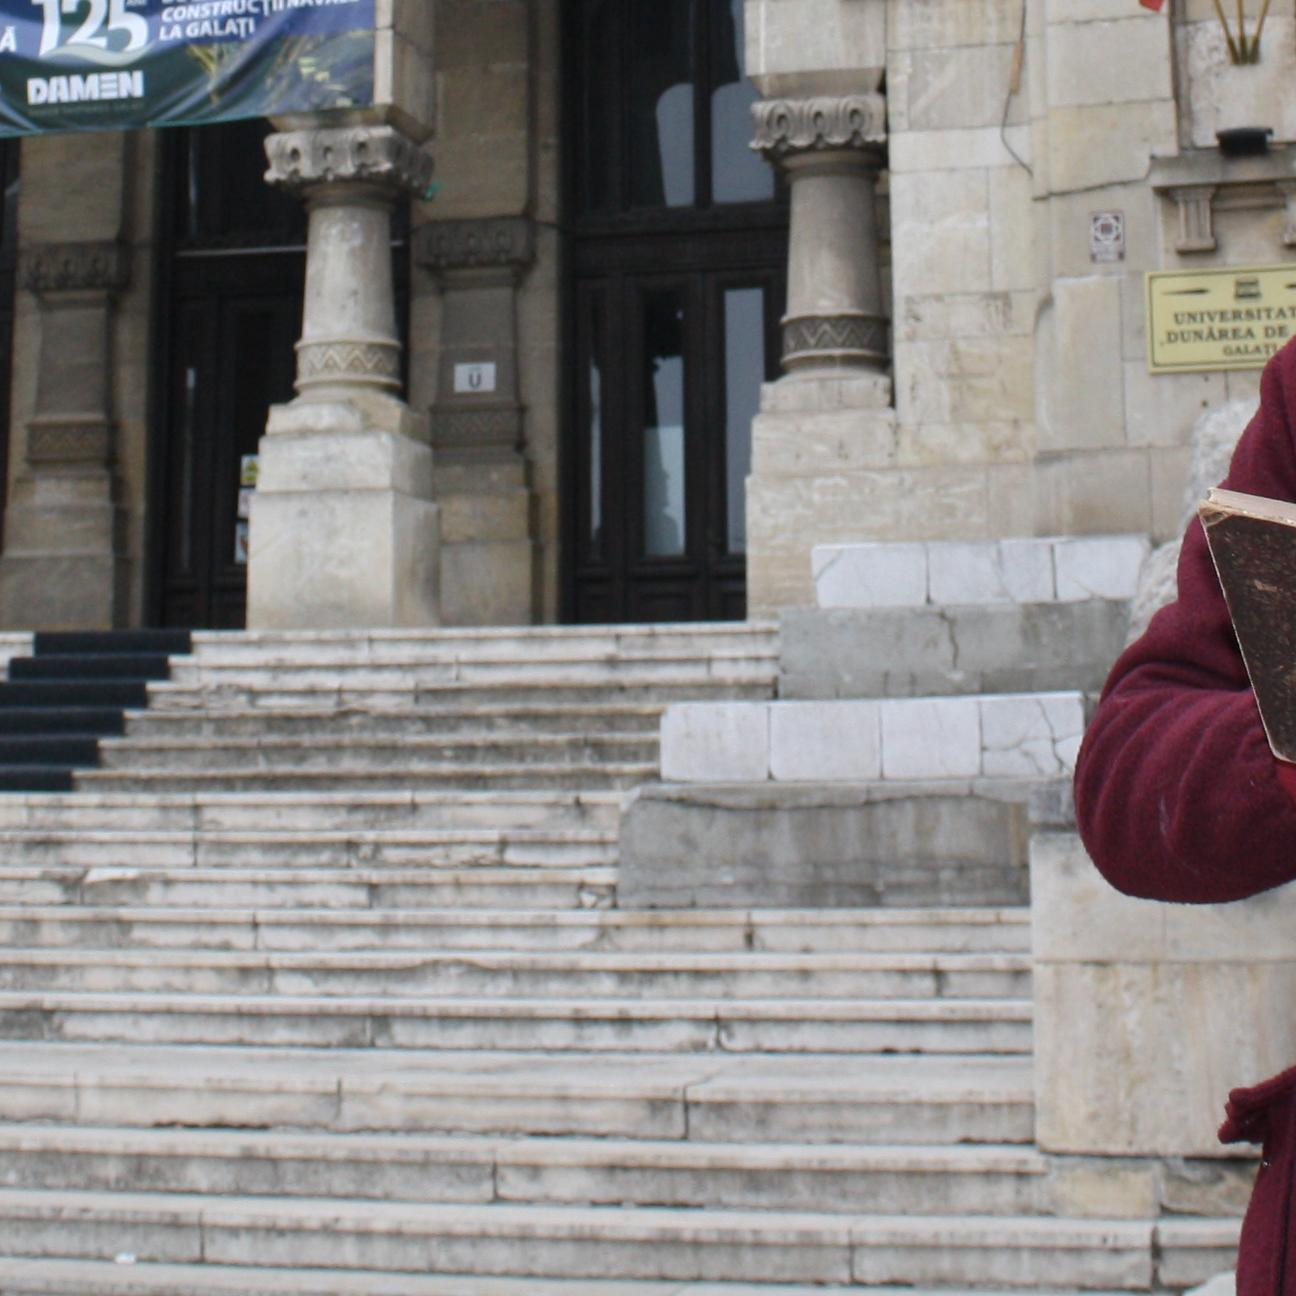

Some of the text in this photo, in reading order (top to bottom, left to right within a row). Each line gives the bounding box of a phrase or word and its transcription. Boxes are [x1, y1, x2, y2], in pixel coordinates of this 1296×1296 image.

[159, 25, 183, 41] LA
[27, 70, 144, 104] DAMEN
[1264, 325, 1289, 339] DE
